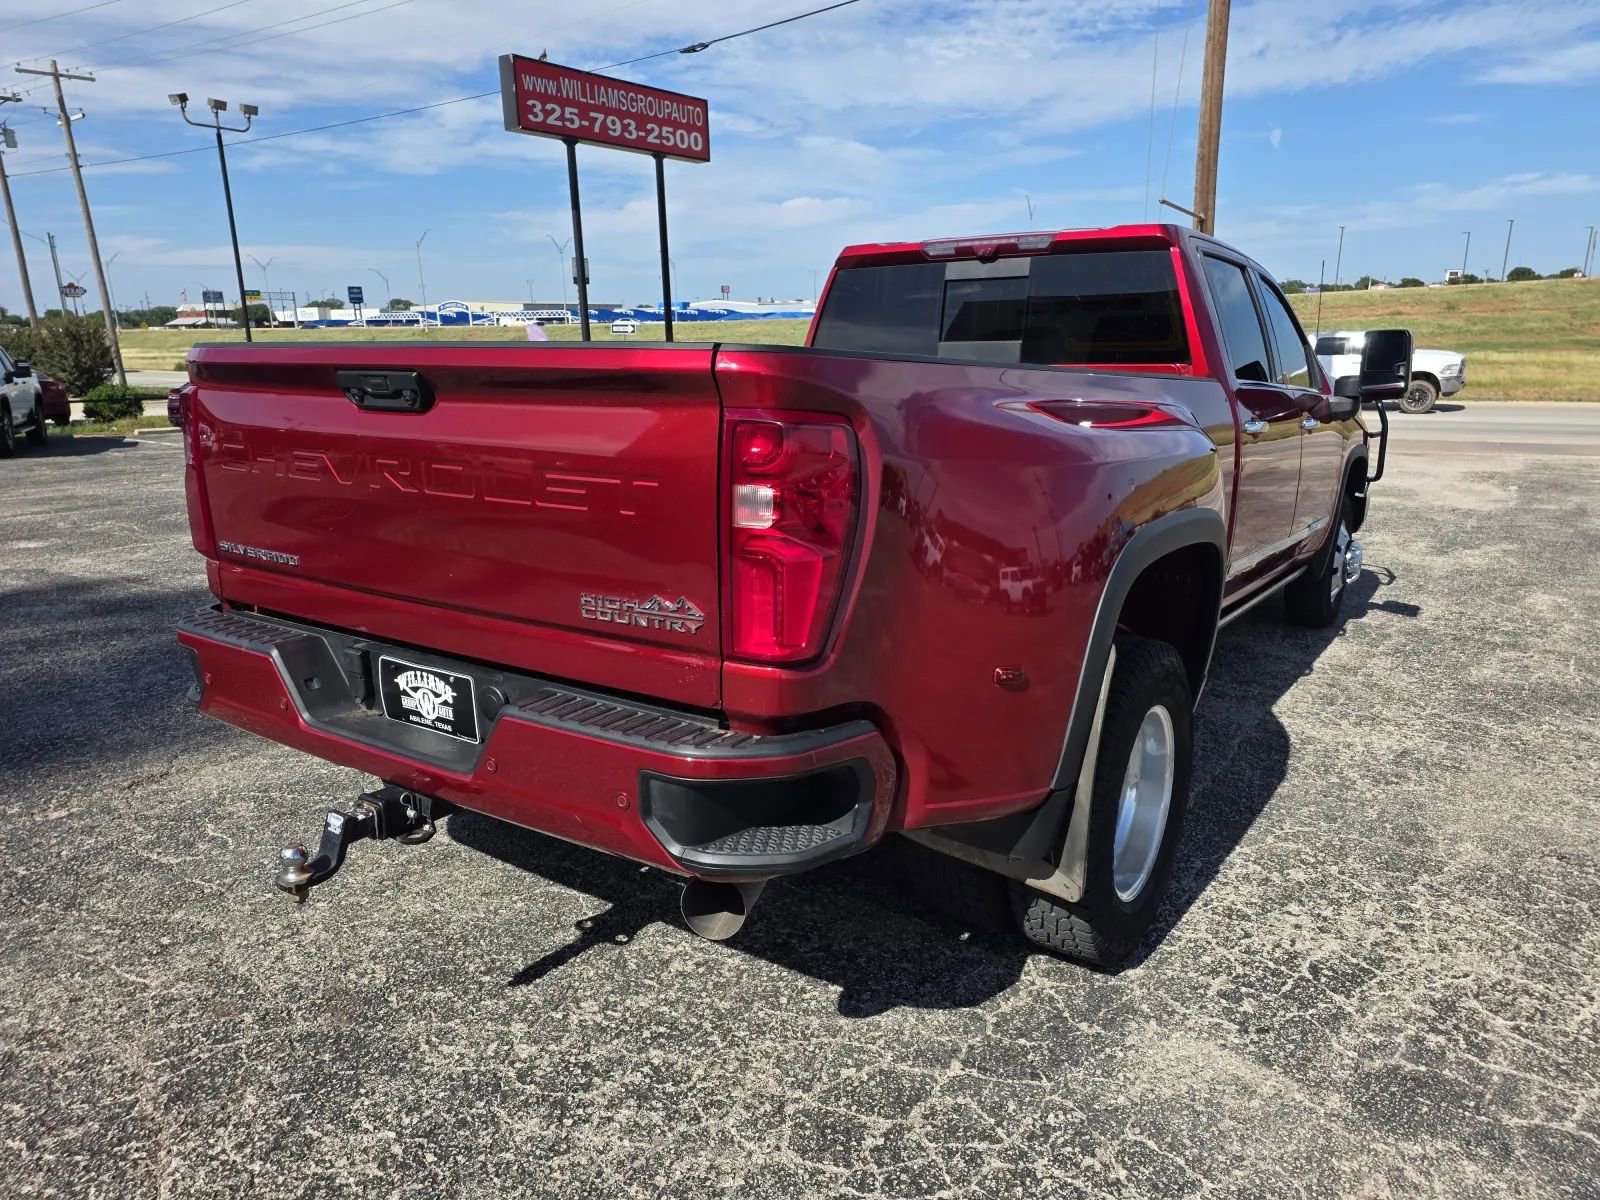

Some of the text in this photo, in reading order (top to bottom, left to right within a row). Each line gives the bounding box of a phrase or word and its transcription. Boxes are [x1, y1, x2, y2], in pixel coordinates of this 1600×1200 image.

[526, 99, 703, 151] 325-793-2500
[220, 441, 659, 515] CHEVROLET
[219, 540, 299, 565] SILVERADO
[580, 592, 639, 611] HIGH
[580, 606, 704, 634] COUNTRY
[396, 671, 454, 703] WILLIAMS
[409, 714, 453, 732] ABILENE, TEXAS
